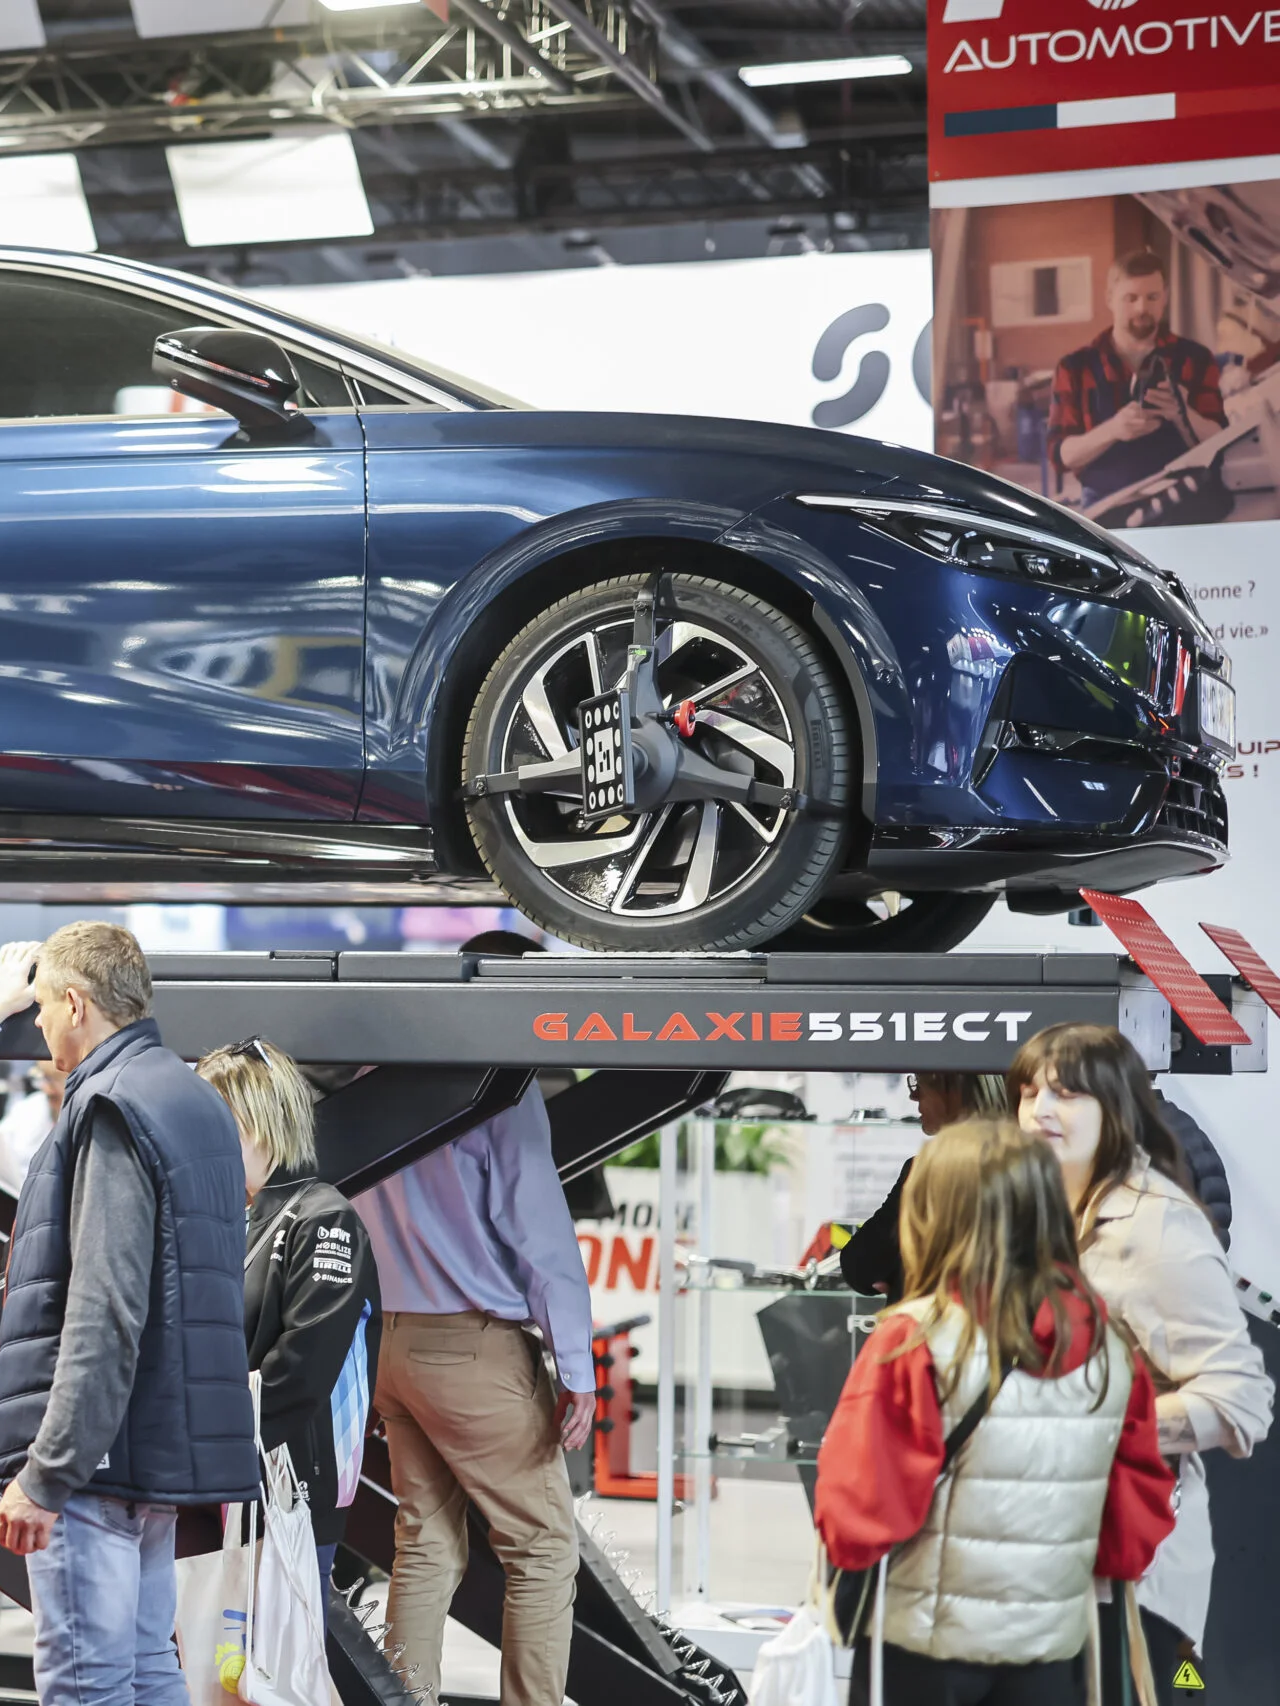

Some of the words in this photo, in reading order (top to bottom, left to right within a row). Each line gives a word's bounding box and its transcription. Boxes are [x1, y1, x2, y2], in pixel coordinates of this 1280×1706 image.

[943, 10, 1280, 73] AUTOMOTIVE
[1247, 579, 1257, 599] ?
[329, 1227, 351, 1243] BWT
[313, 1257, 352, 1274] PIRELLI
[321, 1273, 353, 1283] BINANCE
